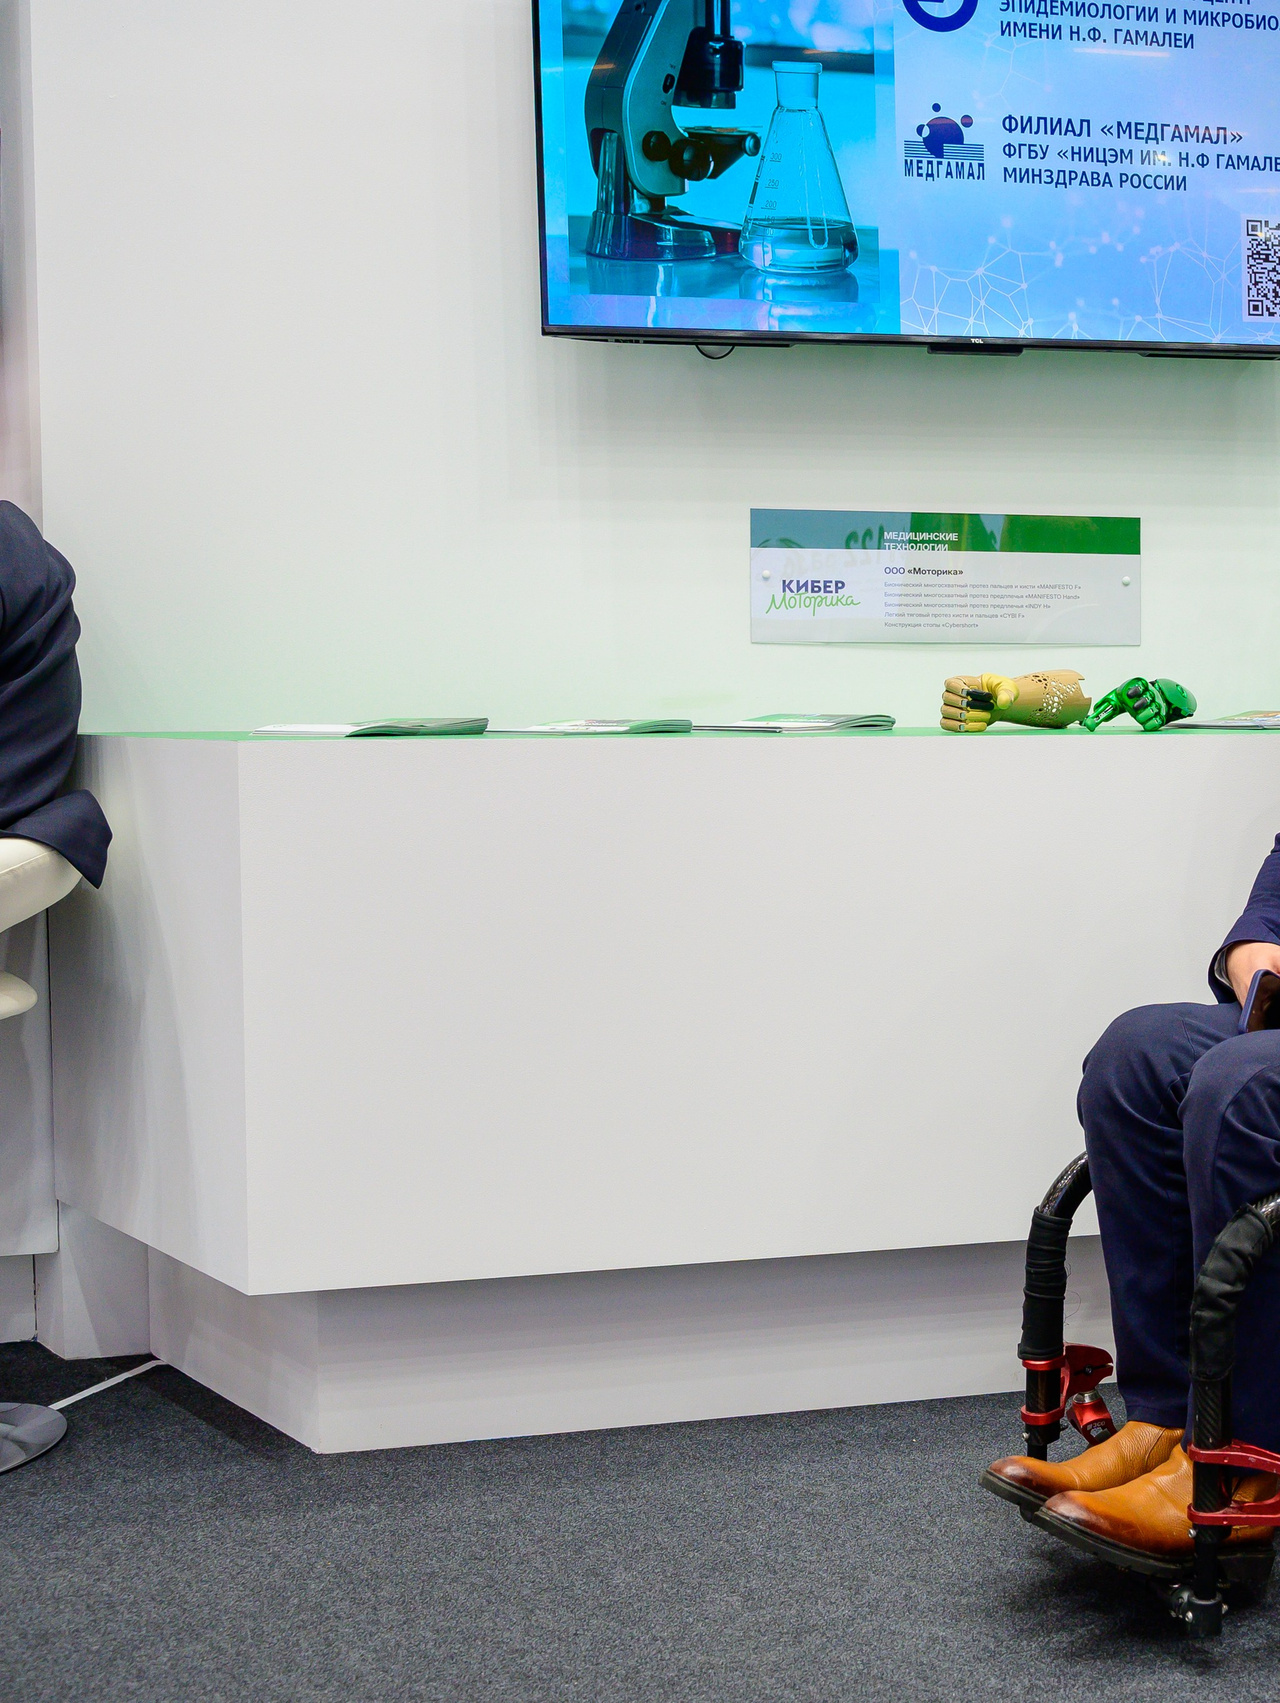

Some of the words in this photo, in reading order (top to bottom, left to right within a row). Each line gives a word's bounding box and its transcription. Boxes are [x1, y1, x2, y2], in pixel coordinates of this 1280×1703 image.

[999, 0, 1159, 24] ЭПИДЕМИОЛОГИИ
[1165, 8, 1177, 24] И
[1000, 20, 1062, 40] ИМЕНИ
[1069, 26, 1107, 44] Н.Ф.
[1114, 28, 1195, 49] ГАМАЛЕИ
[1002, 114, 1091, 137] ФИЛИАЛ
[1100, 120, 1243, 145] «МЕДГАМАЛ»
[1002, 142, 1049, 160] ФГБУ
[1057, 146, 1133, 167] «НИЦЭМ
[1178, 151, 1210, 169] Н.Ф
[904, 159, 985, 181] МЕДГАМАЛ
[1003, 166, 1113, 188] МИНЗДРАВА
[1119, 172, 1187, 191] РОССИИ
[884, 531, 959, 541] МЕДИЦИНСКИЕ
[884, 543, 948, 551] ТЕХНОЛОГИИ
[884, 566, 905, 575] ООО
[907, 567, 964, 577] «Моторика»
[782, 580, 846, 594] КИБЕР
[766, 592, 861, 616] Моторика
